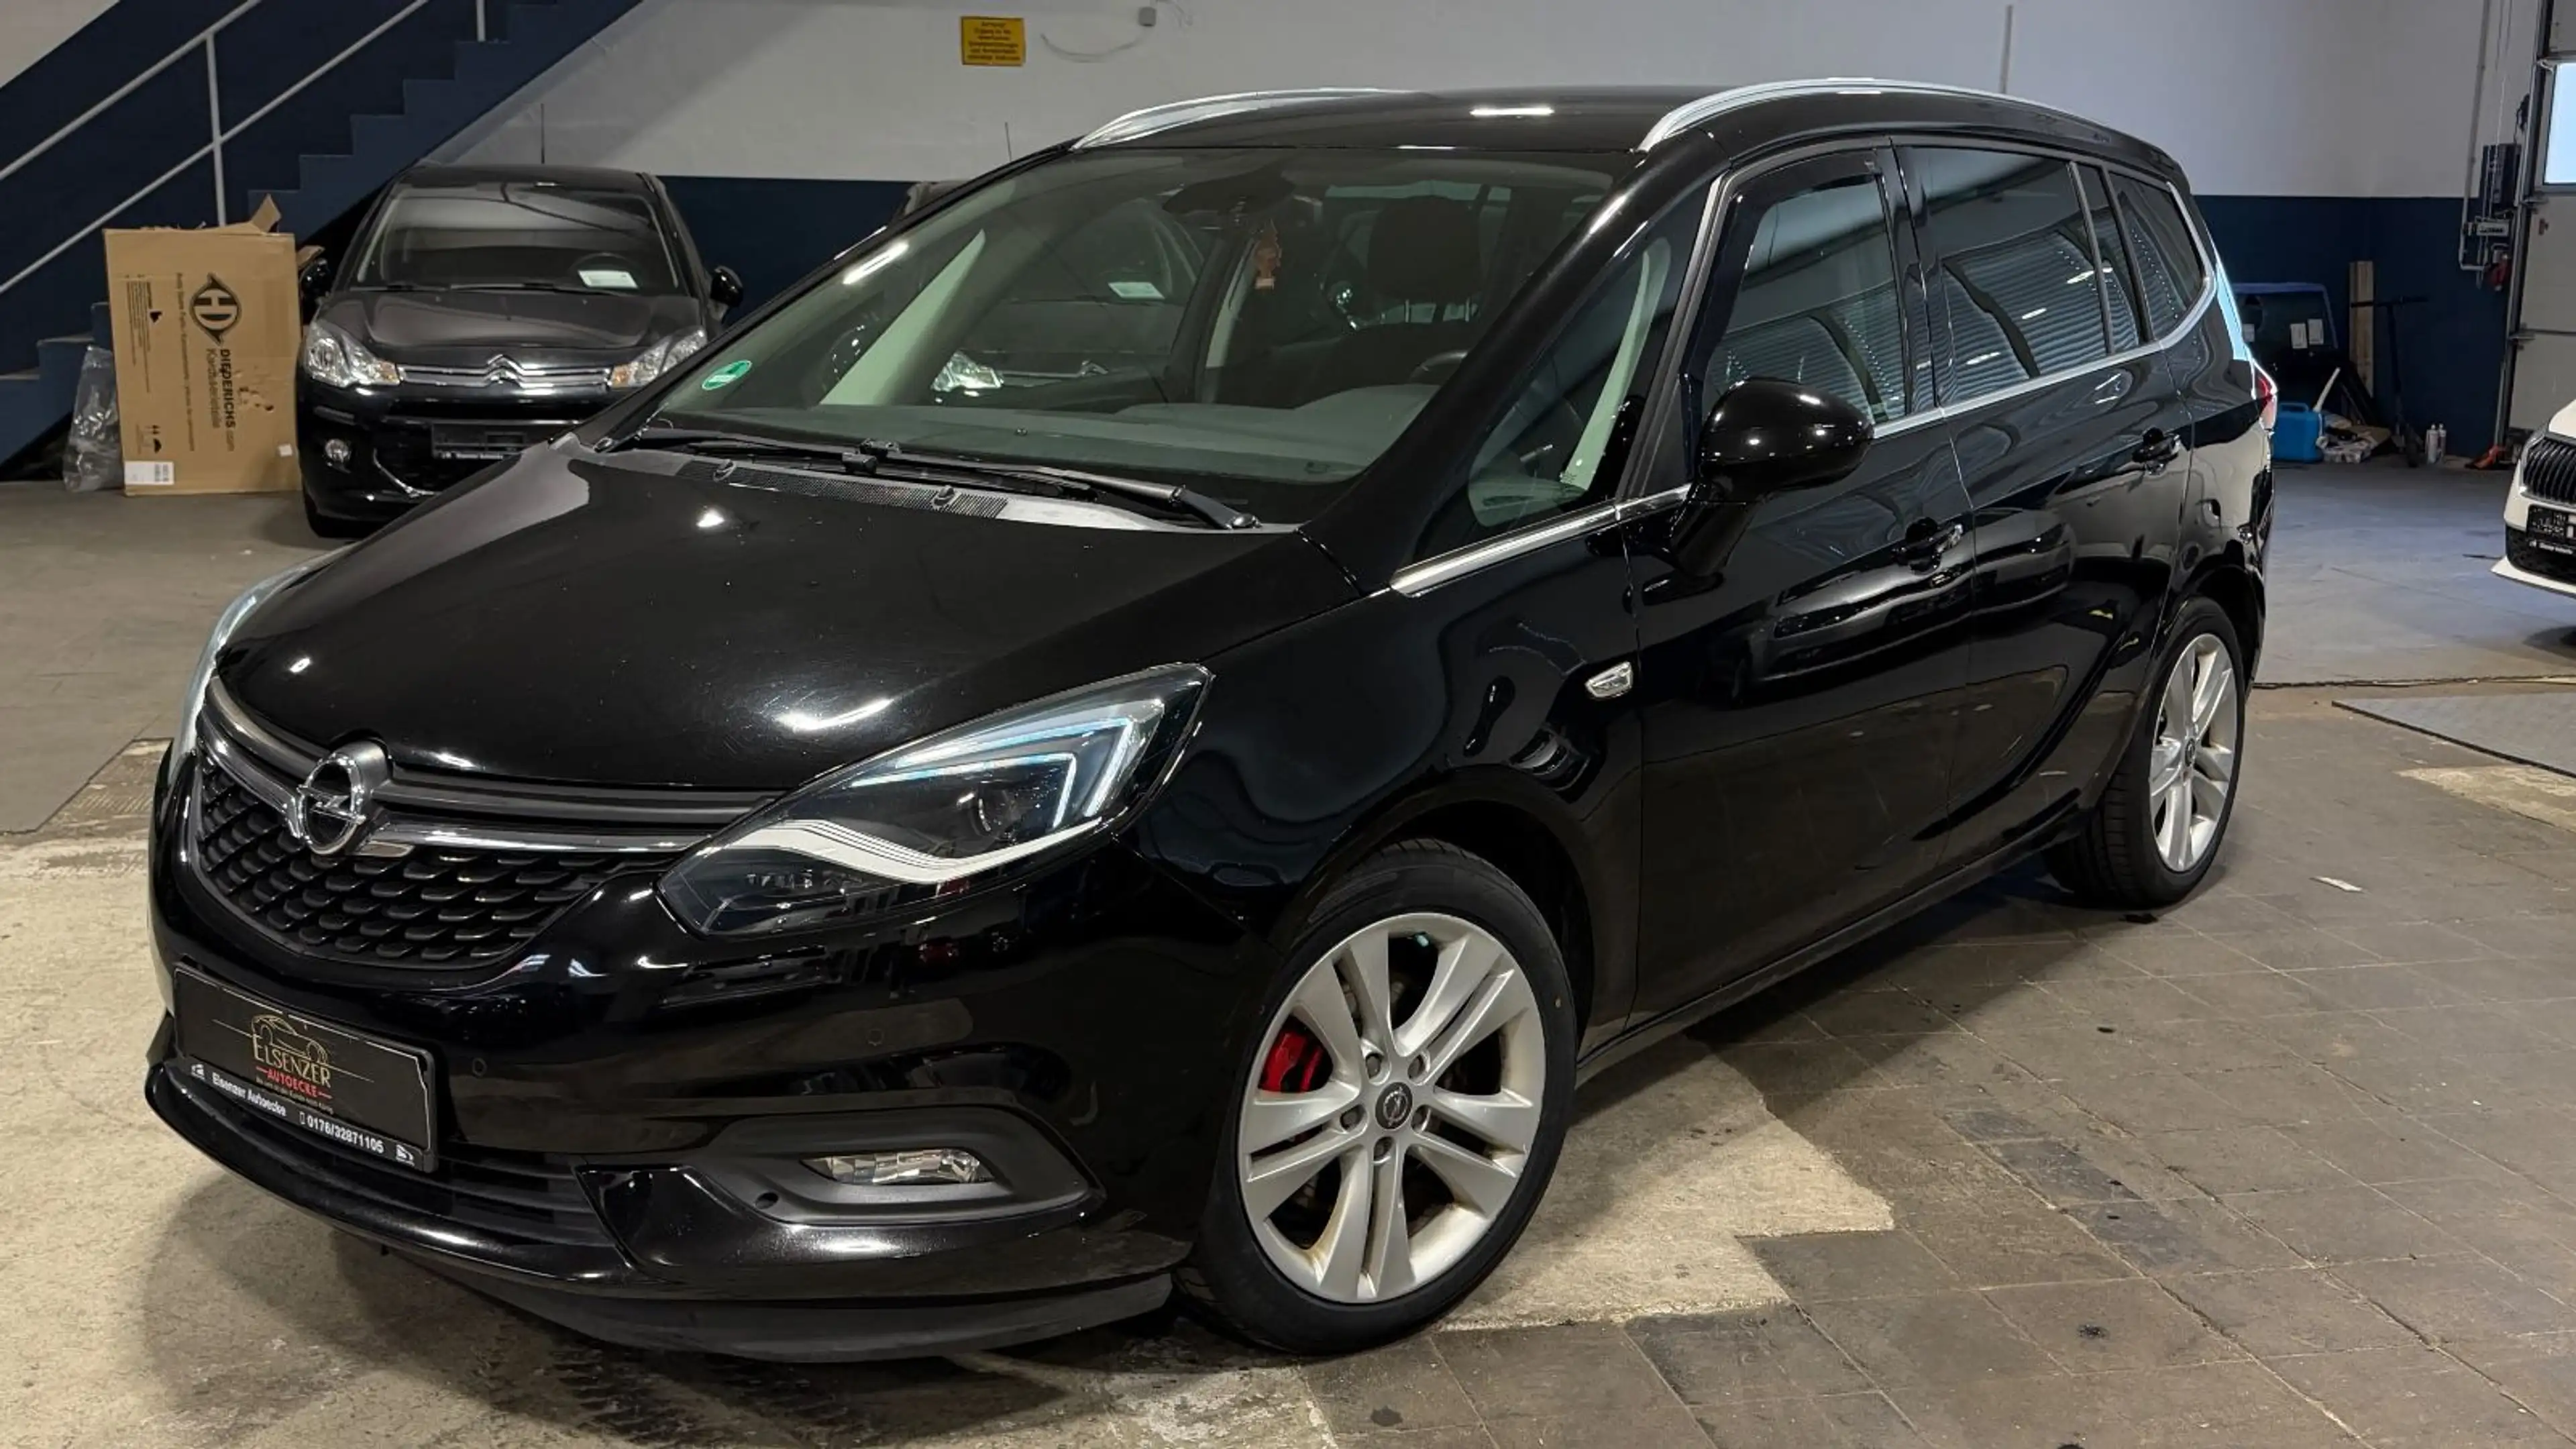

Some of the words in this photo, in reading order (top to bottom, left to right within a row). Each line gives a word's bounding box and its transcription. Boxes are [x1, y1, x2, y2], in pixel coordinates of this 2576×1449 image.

[220, 348, 236, 428] DIEDERICHS
[252, 1034, 331, 1087] ELSENZER
[307, 1114, 384, 1154] 0176/32871105
